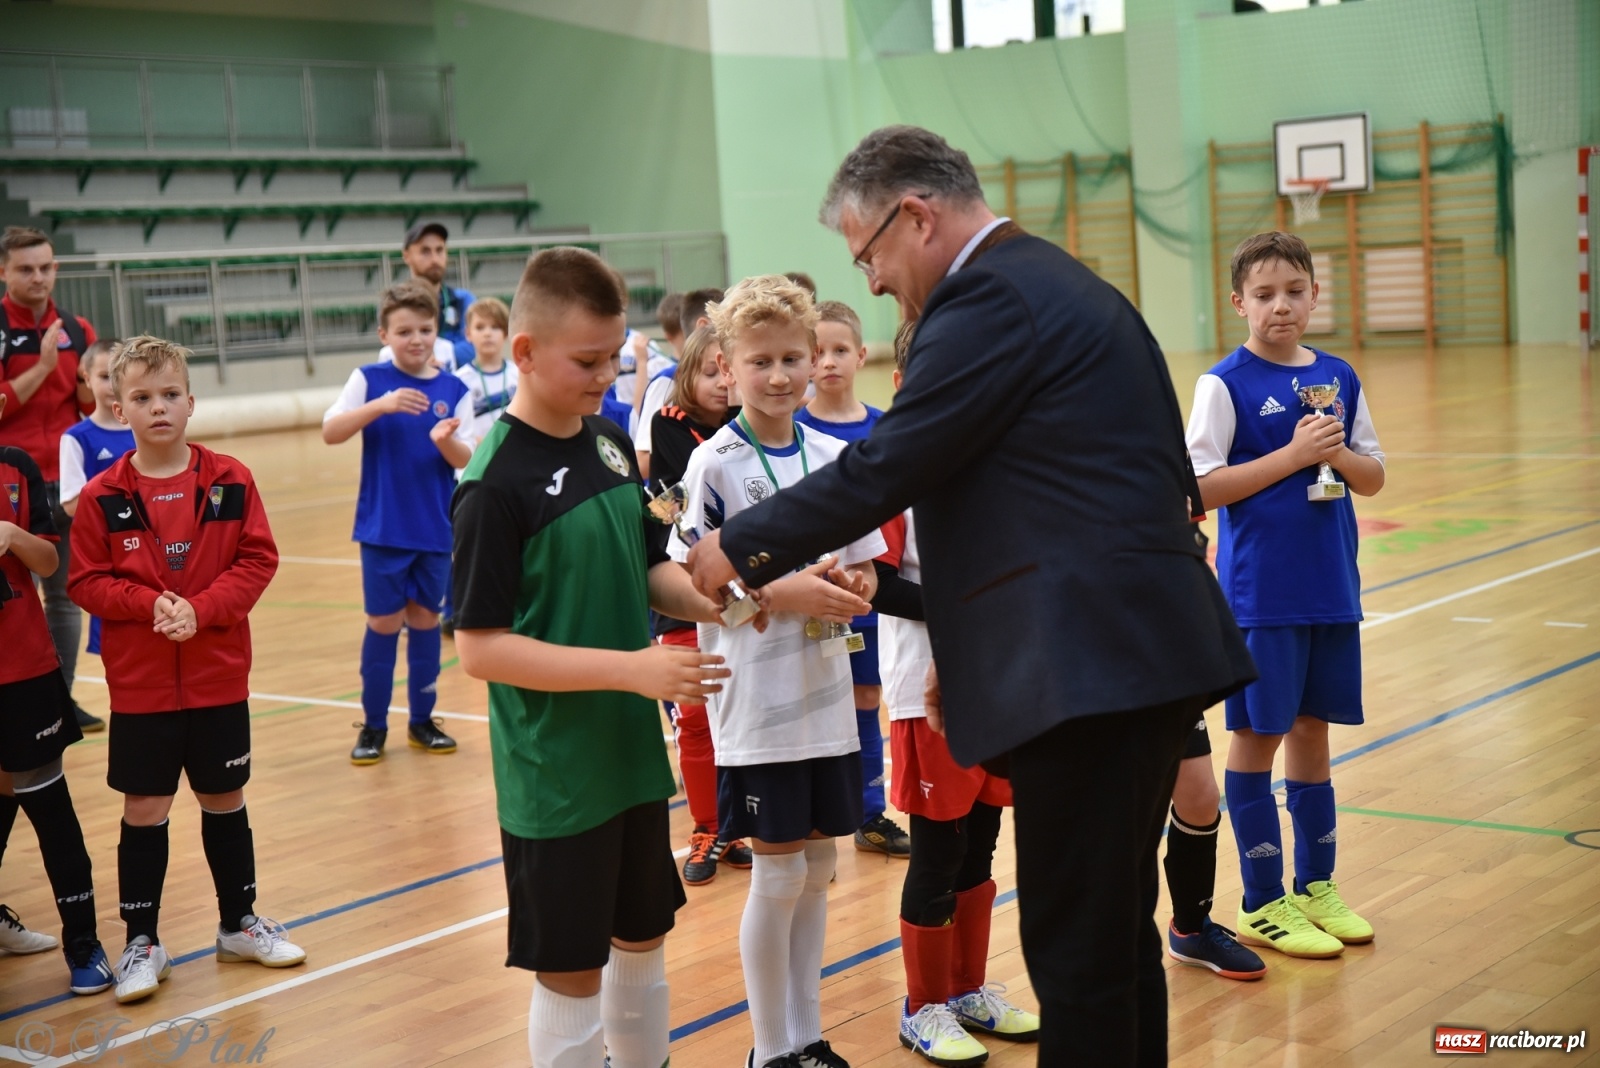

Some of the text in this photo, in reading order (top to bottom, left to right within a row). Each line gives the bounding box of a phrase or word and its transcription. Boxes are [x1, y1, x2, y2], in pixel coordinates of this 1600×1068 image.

[1259, 405, 1286, 417] adidas
[152, 492, 184, 502] regio
[123, 536, 140, 551] SD
[165, 541, 192, 555] HDK
[57, 889, 94, 904] regi
